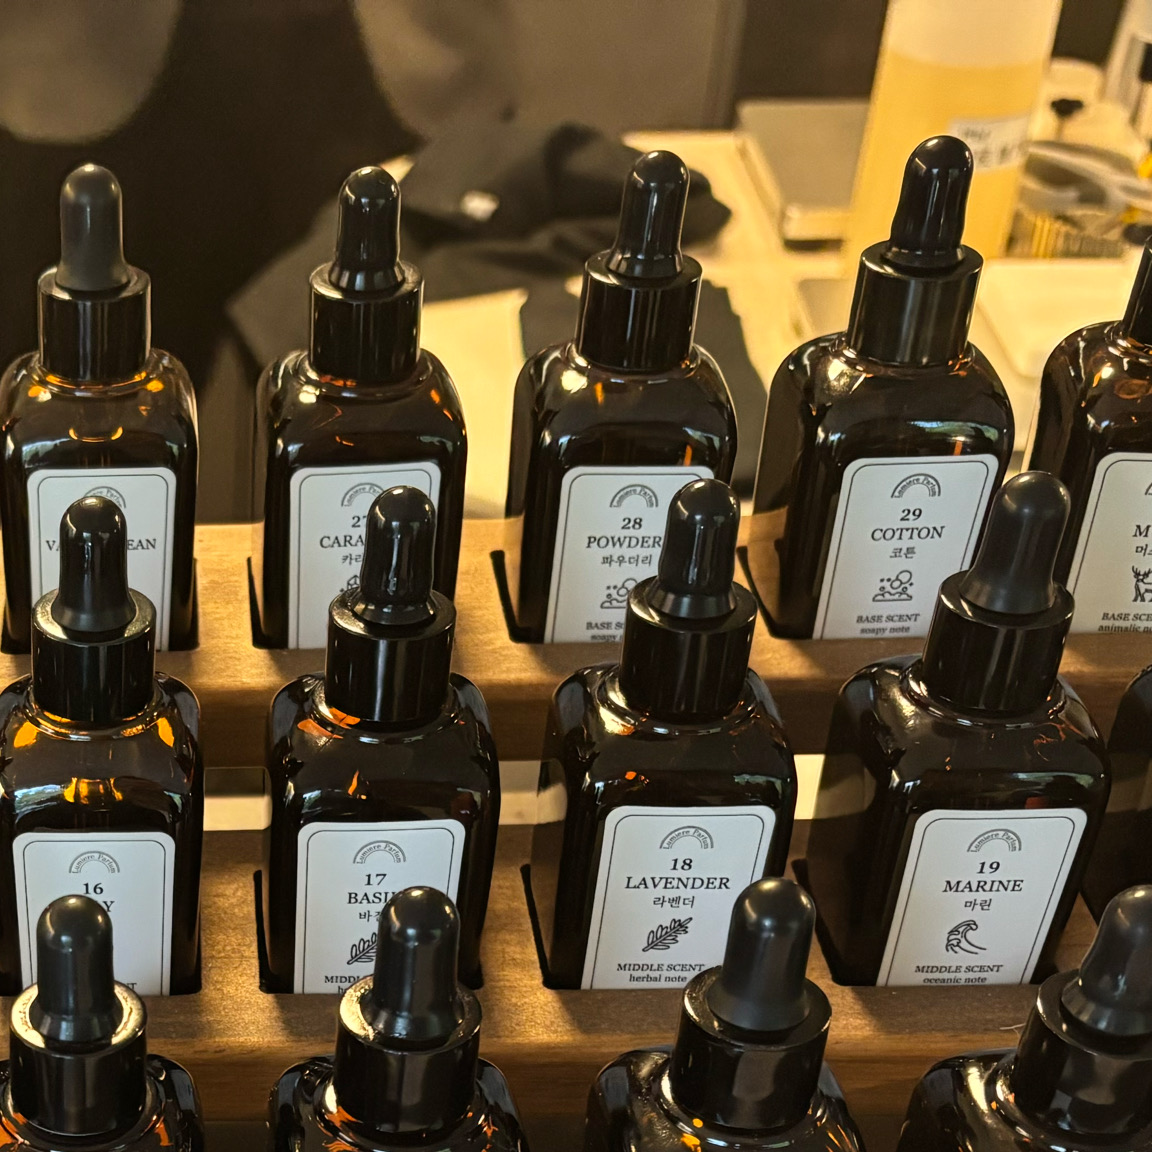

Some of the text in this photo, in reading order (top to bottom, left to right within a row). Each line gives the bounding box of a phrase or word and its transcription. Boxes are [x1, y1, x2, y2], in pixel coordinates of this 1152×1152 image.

[900, 508, 922, 521] 29
[621, 518, 643, 530] 28
[871, 526, 945, 541] COTTON
[320, 535, 364, 548] CARA
[586, 536, 662, 548] POWDER
[601, 555, 652, 567] 파우더리
[857, 614, 920, 623] BASE SCENT
[586, 622, 613, 630] BASE
[670, 858, 693, 871] 18
[976, 861, 1000, 874] 19
[365, 874, 387, 886] 17
[625, 876, 730, 889] LAVENDER
[942, 880, 1024, 892] MARINE
[83, 883, 103, 894] 16
[347, 892, 396, 904] BASI
[653, 896, 695, 908] 라벤더
[964, 899, 992, 911] 마린
[617, 963, 705, 971] MIDDLE SCENT
[915, 965, 962, 973] MIDDLE
[923, 976, 961, 984] oceanic
